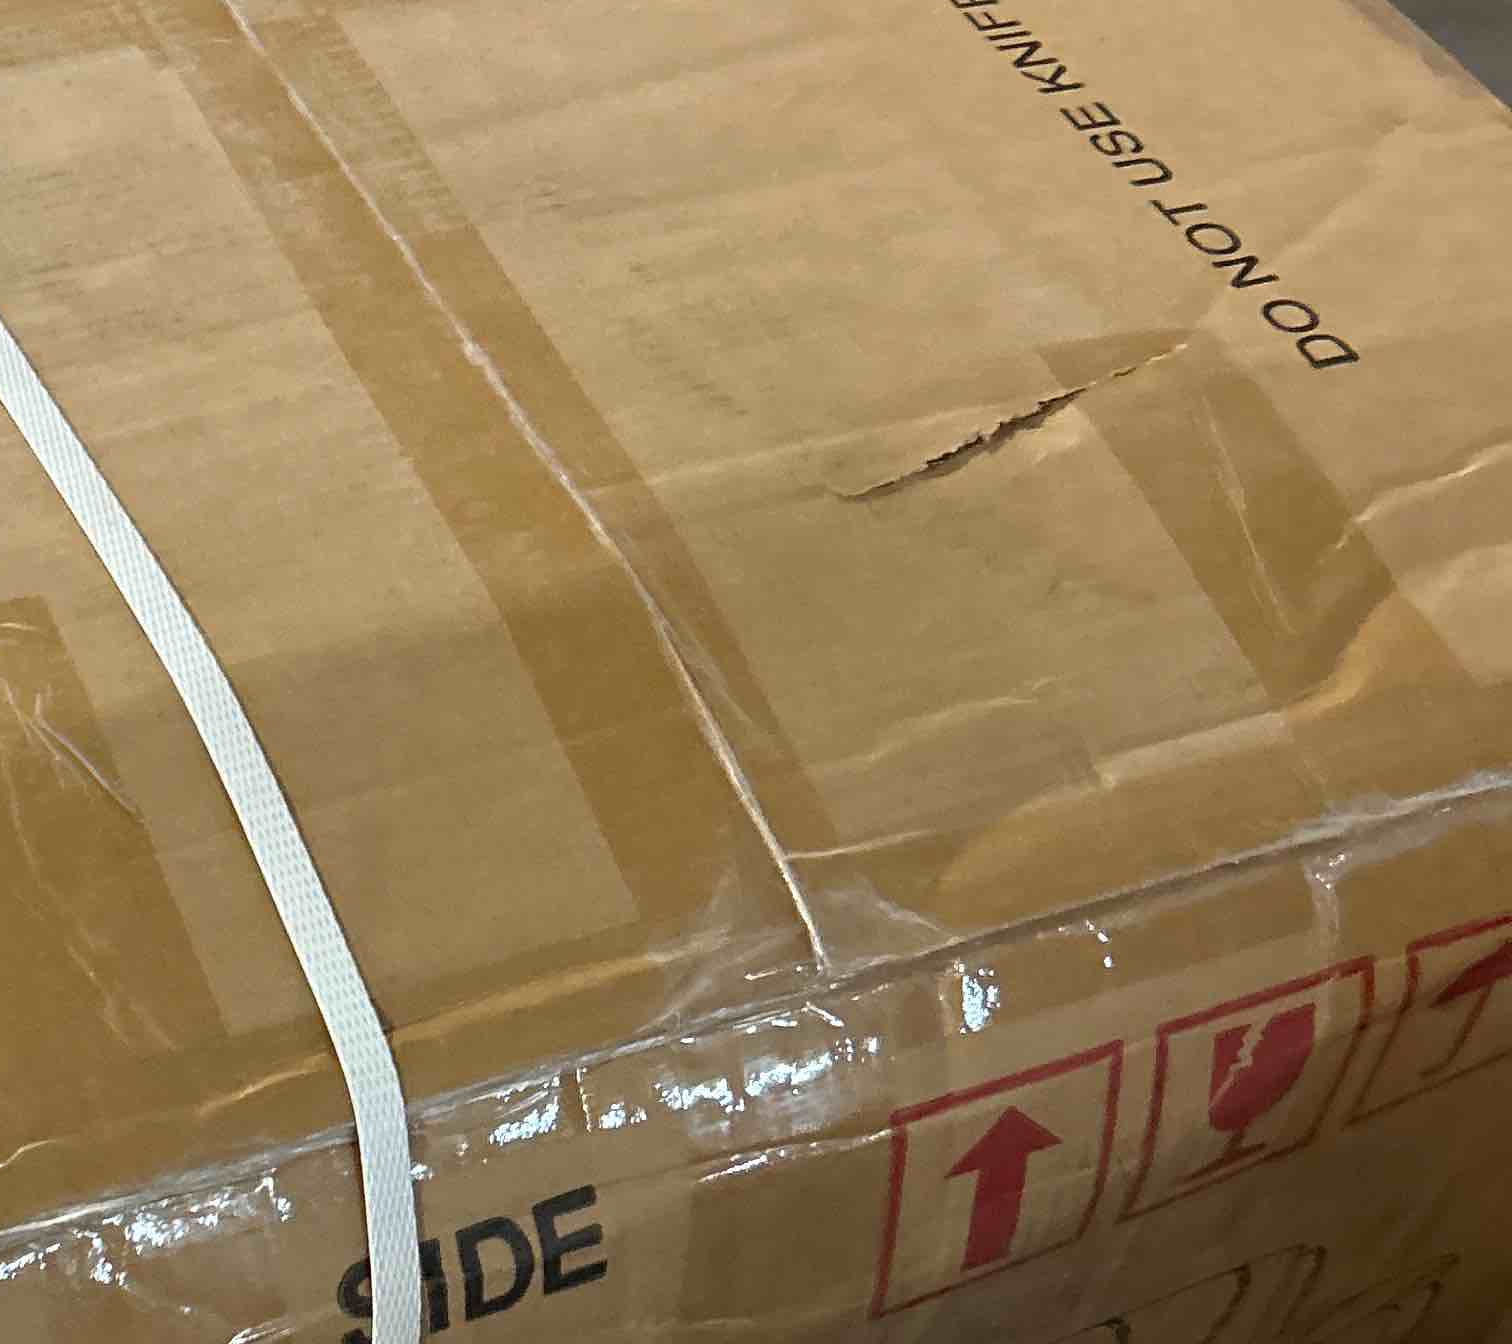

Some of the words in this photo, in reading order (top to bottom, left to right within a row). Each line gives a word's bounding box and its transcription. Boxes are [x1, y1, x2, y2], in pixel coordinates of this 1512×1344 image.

[1061, 101, 1174, 188] USE
[1148, 196, 1279, 290] NOT
[1262, 298, 1361, 370] DO
